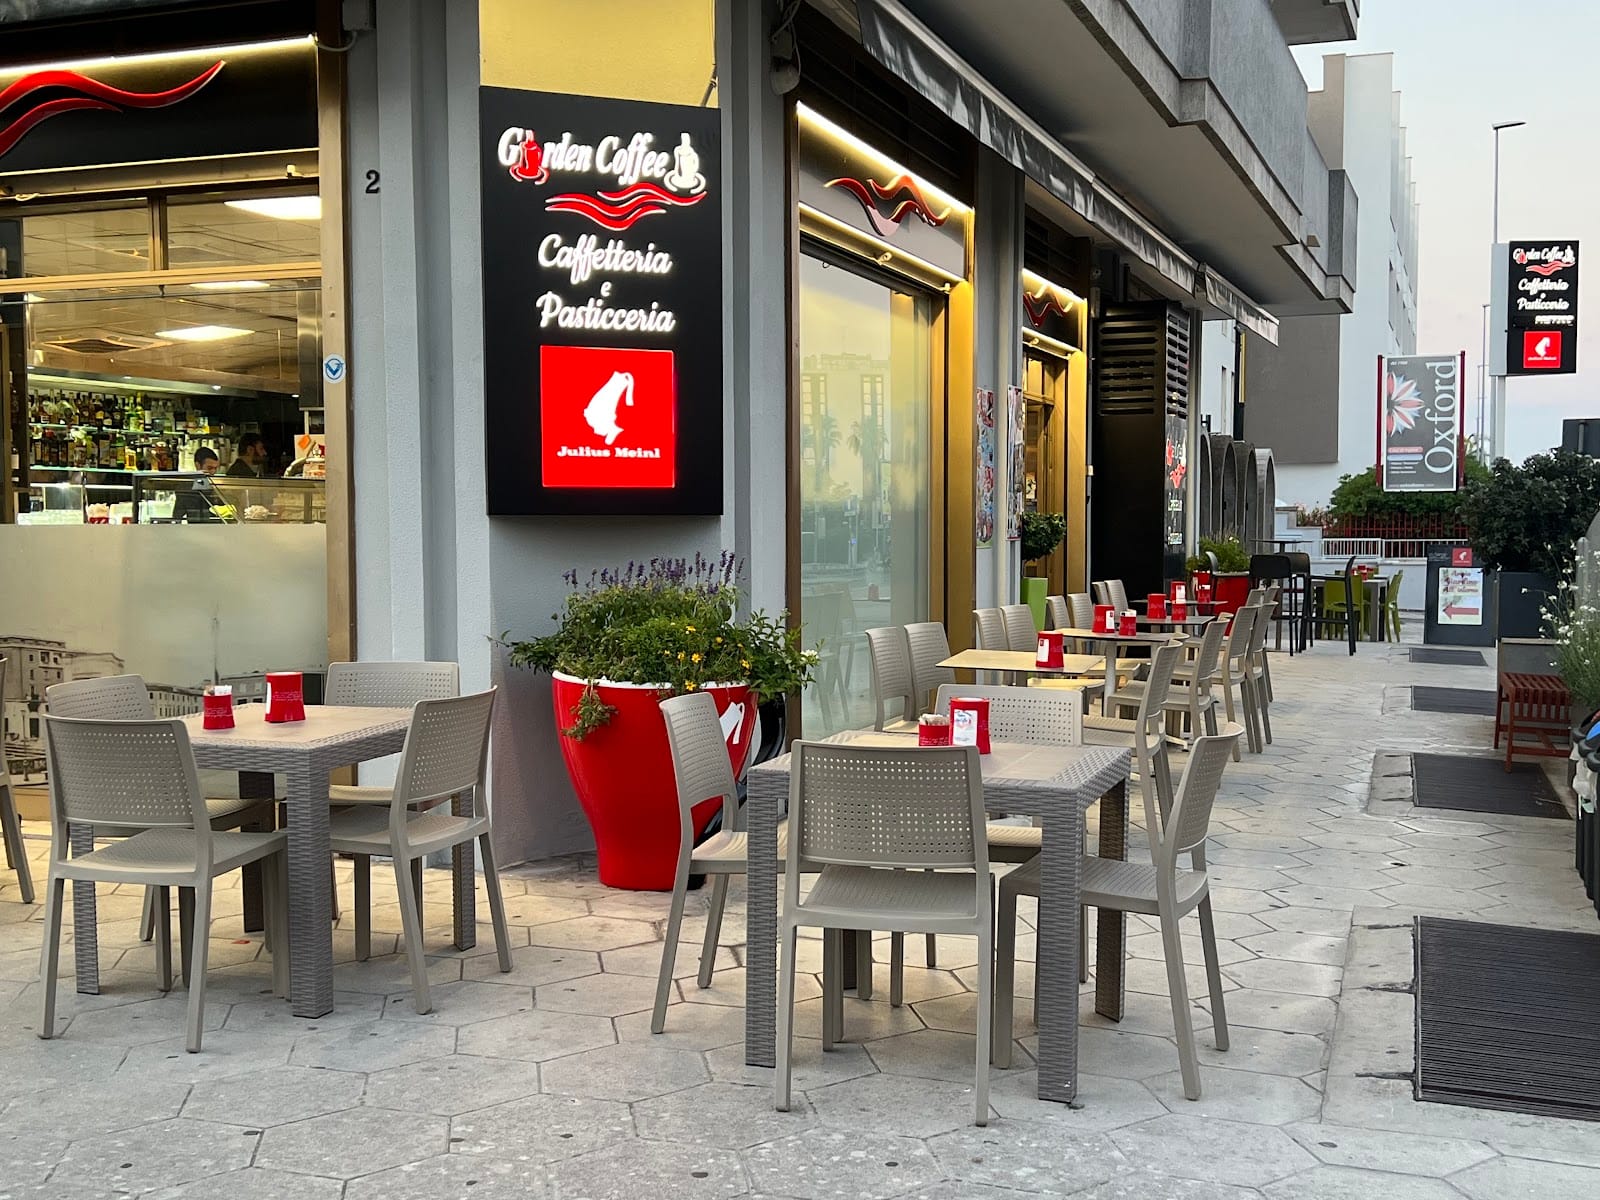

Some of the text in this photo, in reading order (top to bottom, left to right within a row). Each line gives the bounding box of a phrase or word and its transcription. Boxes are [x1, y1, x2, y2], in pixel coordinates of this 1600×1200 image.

[596, 132, 670, 185] Coffee
[365, 170, 381, 194] 2
[537, 234, 673, 285] Caffetteria
[600, 281, 612, 297] e
[1518, 278, 1570, 296] Caffetteria
[535, 291, 677, 333] Pasticceria
[1424, 358, 1456, 474] Oxford
[557, 446, 661, 459] Julius Meinl
